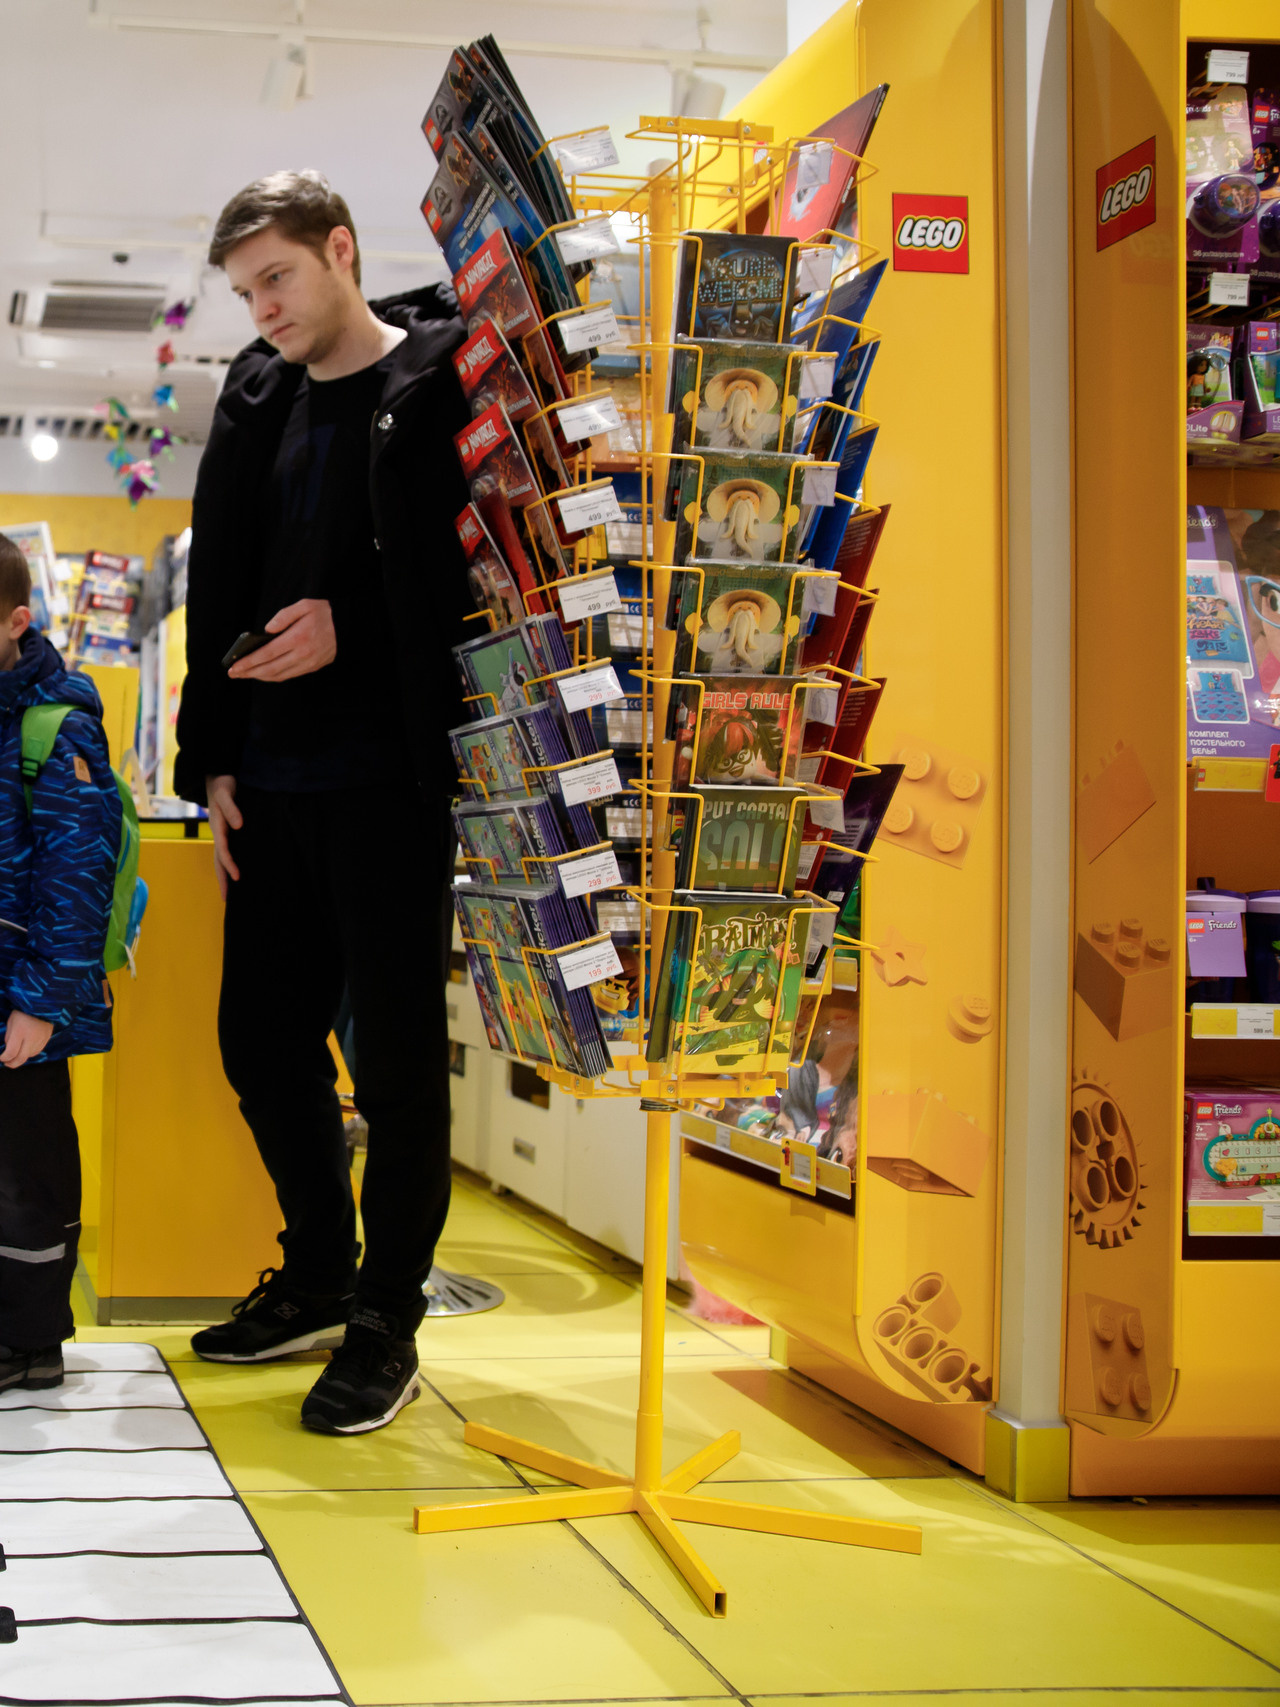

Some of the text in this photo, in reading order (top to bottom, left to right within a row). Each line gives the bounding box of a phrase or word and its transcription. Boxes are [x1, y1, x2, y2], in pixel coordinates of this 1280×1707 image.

[1100, 165, 1152, 223] LEGO
[897, 216, 965, 250] LEGO
[588, 333, 602, 343] 499
[588, 512, 602, 522] 499
[587, 602, 601, 612] 499
[589, 692, 603, 702] 299
[702, 692, 791, 710] GIRLS RULE
[1188, 731, 1230, 739] КОМПЛЕКТ
[1190, 739, 1246, 748] ПОСТЕЛЬНОГО
[1192, 747, 1217, 755] БЕЛЬЯ
[587, 786, 601, 795] 399
[702, 801, 734, 819] PUT
[588, 878, 602, 888] 299
[1189, 922, 1204, 930] LEGO
[701, 912, 797, 957] BATMAN
[588, 968, 602, 978] 199
[1197, 1103, 1242, 1117] LEGO Friends
[363, 1307, 381, 1318] new
[353, 1312, 387, 1328] balance
